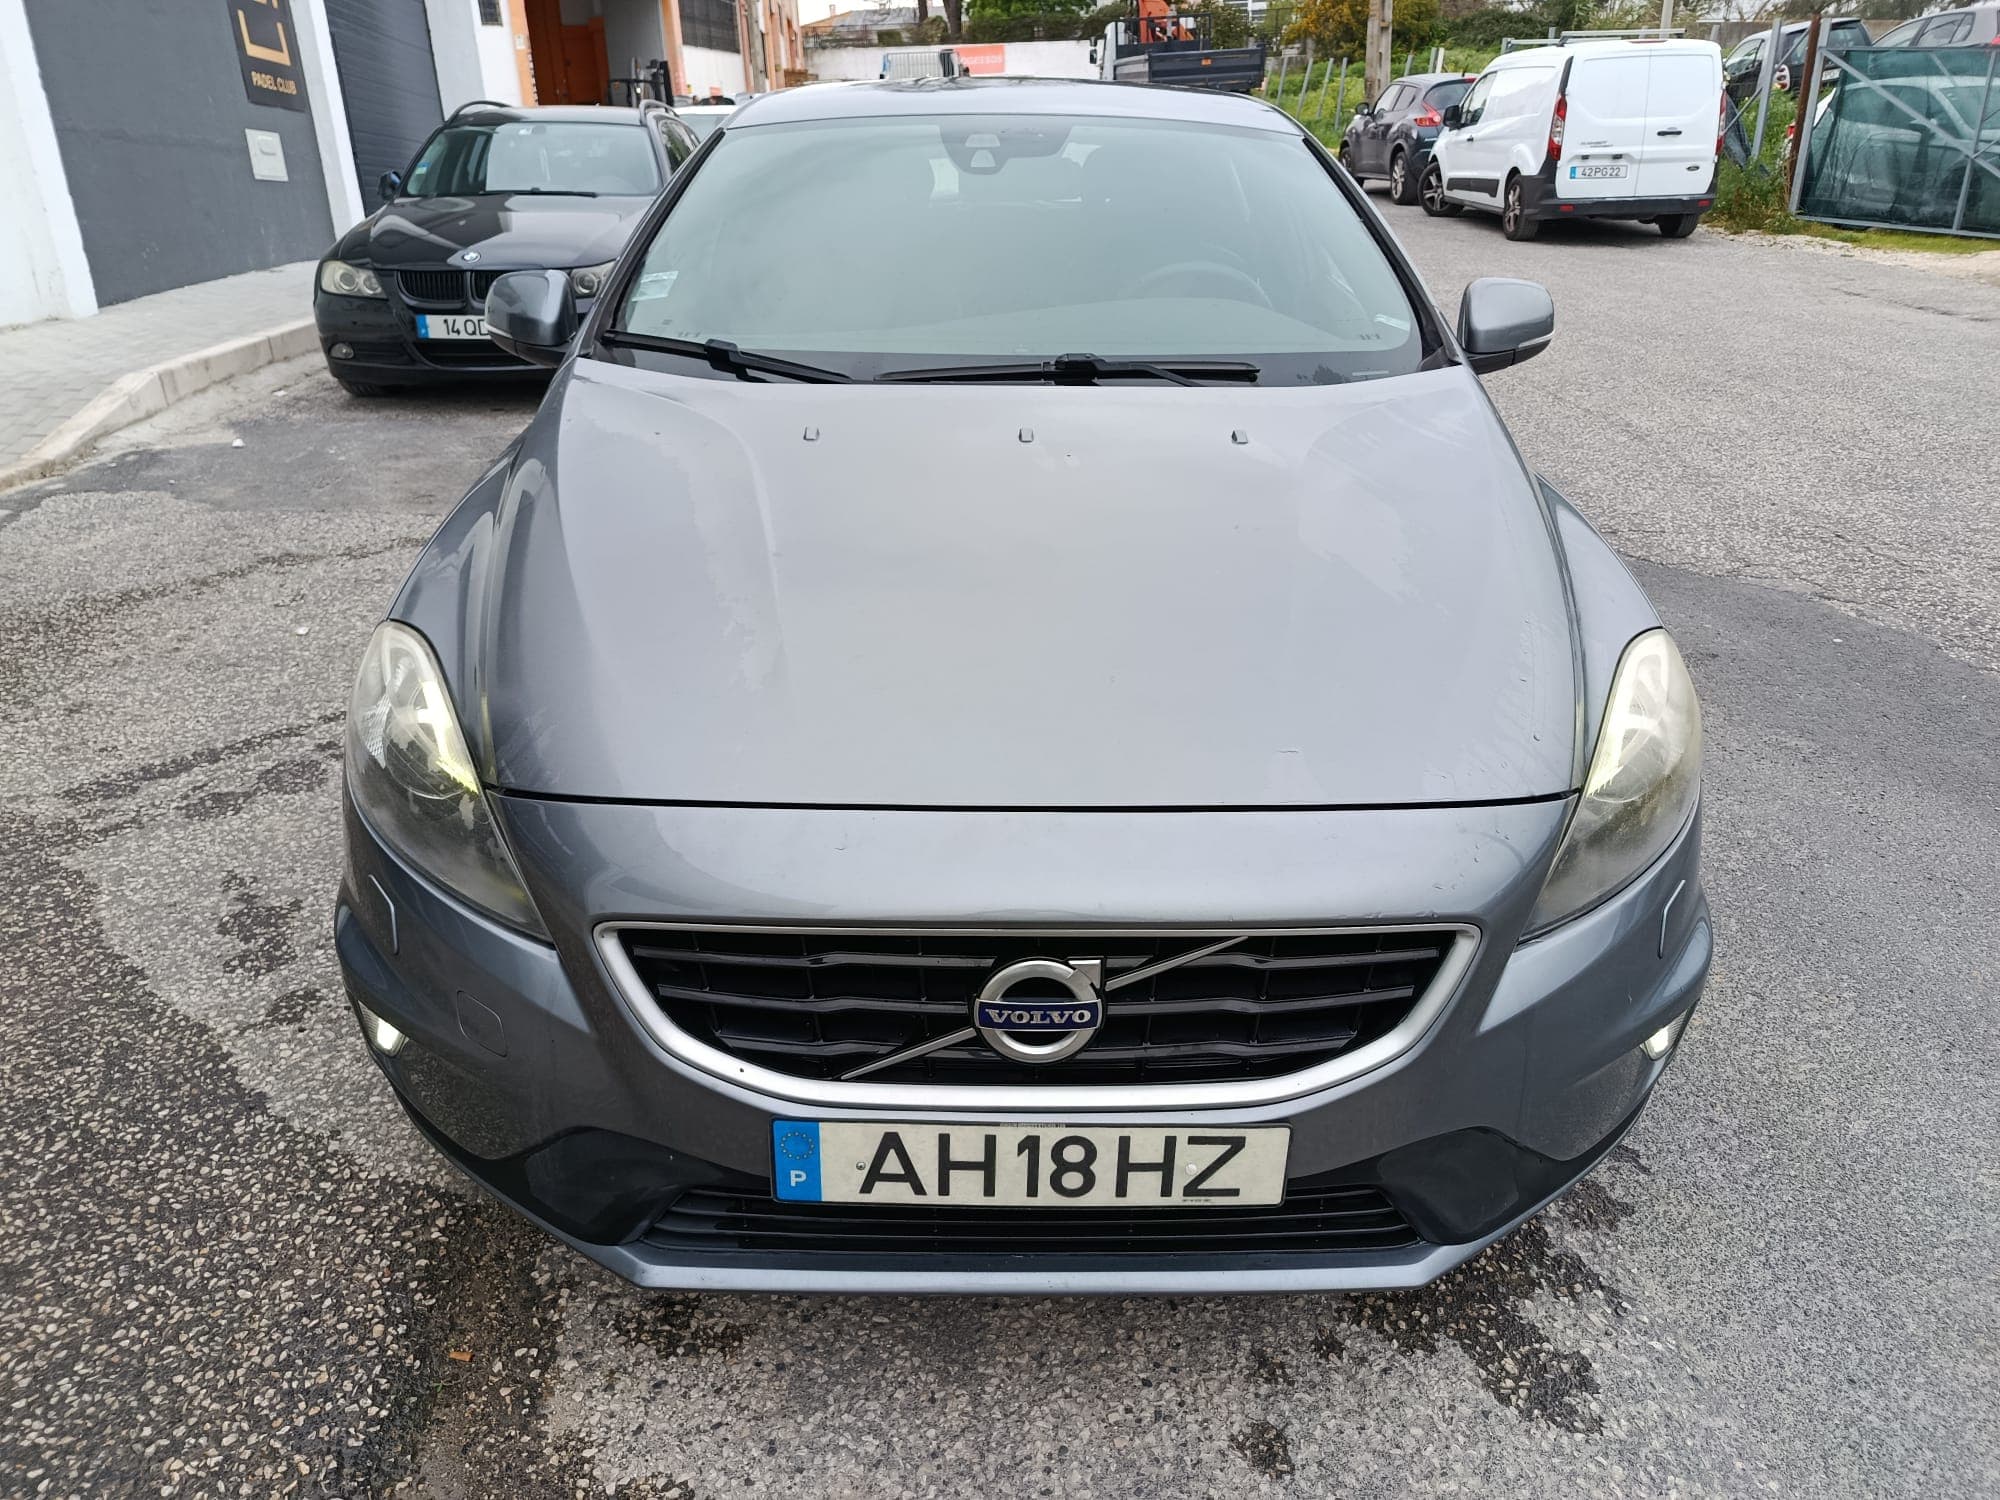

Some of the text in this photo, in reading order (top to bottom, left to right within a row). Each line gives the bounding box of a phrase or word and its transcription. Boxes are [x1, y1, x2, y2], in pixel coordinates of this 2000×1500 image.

[251, 71, 297, 95] PADEL CLUB
[985, 1008, 1091, 1024] VOLVO
